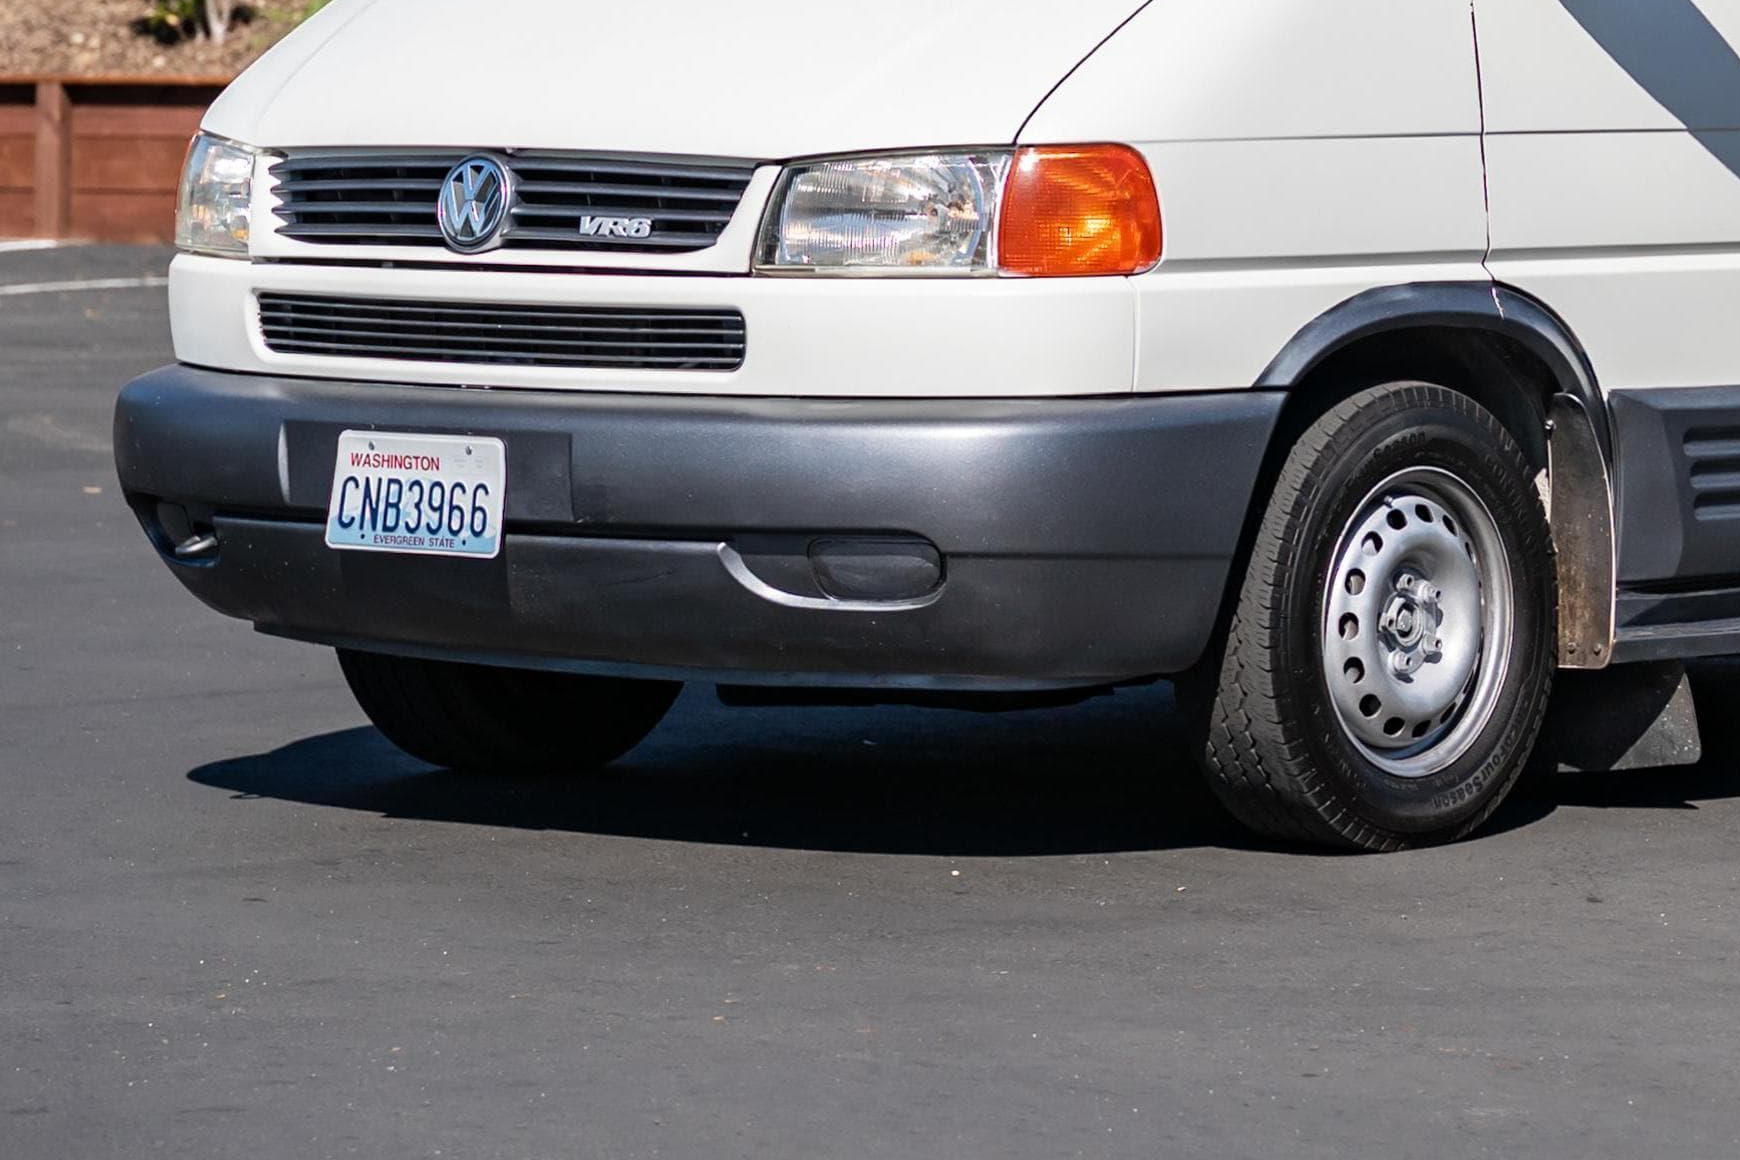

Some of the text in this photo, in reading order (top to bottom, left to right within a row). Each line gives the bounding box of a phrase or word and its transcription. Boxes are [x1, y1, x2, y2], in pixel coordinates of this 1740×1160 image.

[441, 158, 502, 241] VW
[580, 215, 652, 238] VR6
[350, 452, 440, 471] WASHINGTON
[338, 475, 490, 538] CNB3966
[373, 534, 455, 548] EVERGREEN STATE
